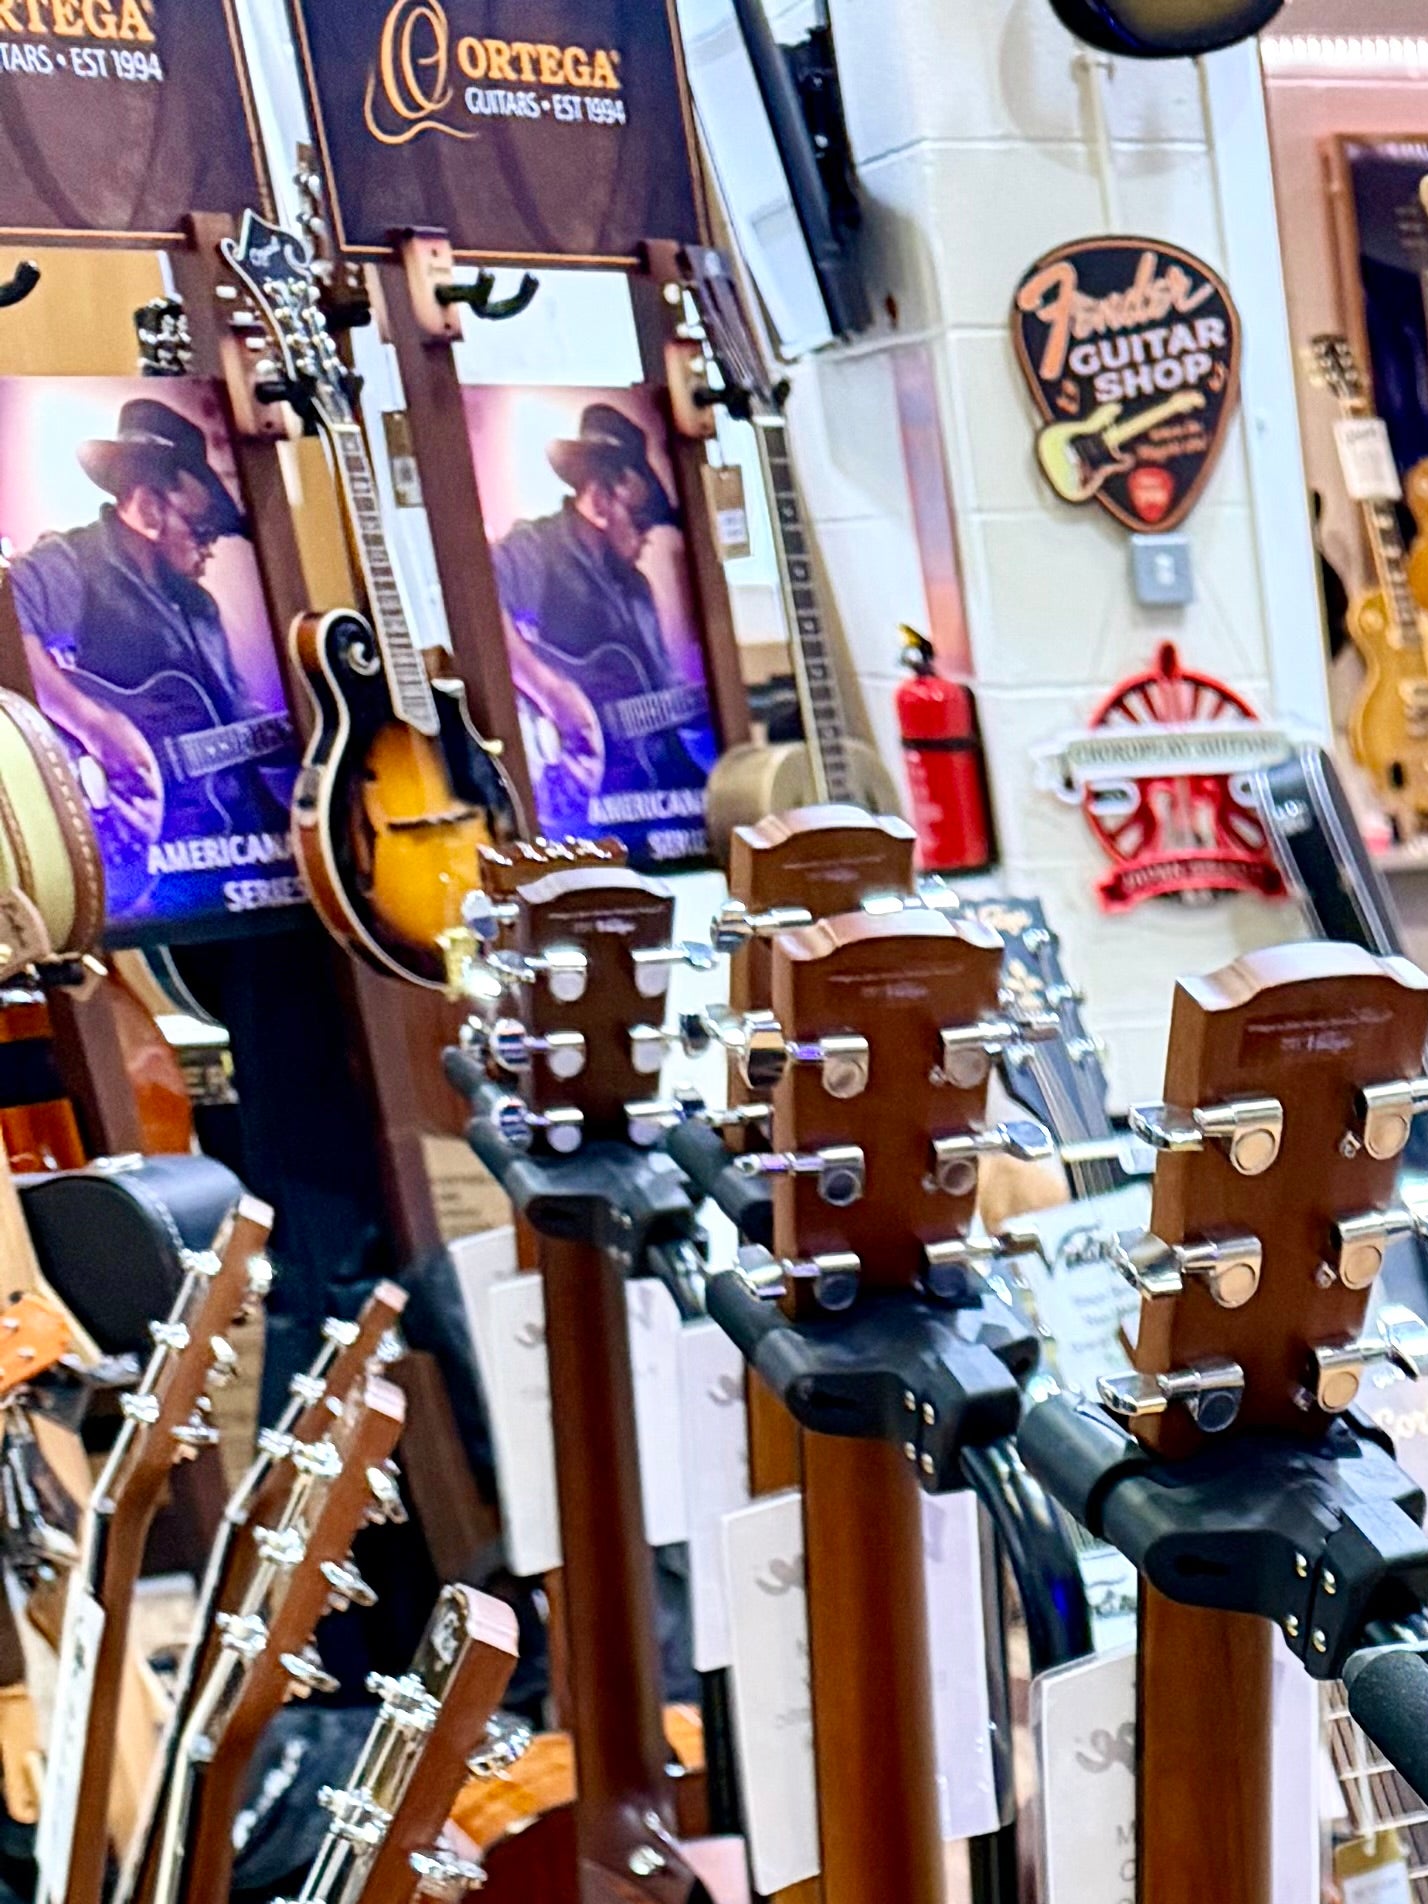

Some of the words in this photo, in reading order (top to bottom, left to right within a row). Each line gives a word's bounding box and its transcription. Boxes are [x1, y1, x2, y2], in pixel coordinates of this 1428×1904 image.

[0, 43, 53, 74] TARS
[70, 48, 108, 78] EST
[111, 50, 164, 81] 1994
[457, 37, 621, 90] ORTEGA
[465, 87, 541, 119] GUITARS
[552, 94, 583, 122] EST
[1017, 251, 1215, 380] Fender
[1068, 317, 1227, 376] GUITAR
[1093, 352, 1213, 402] SHOP
